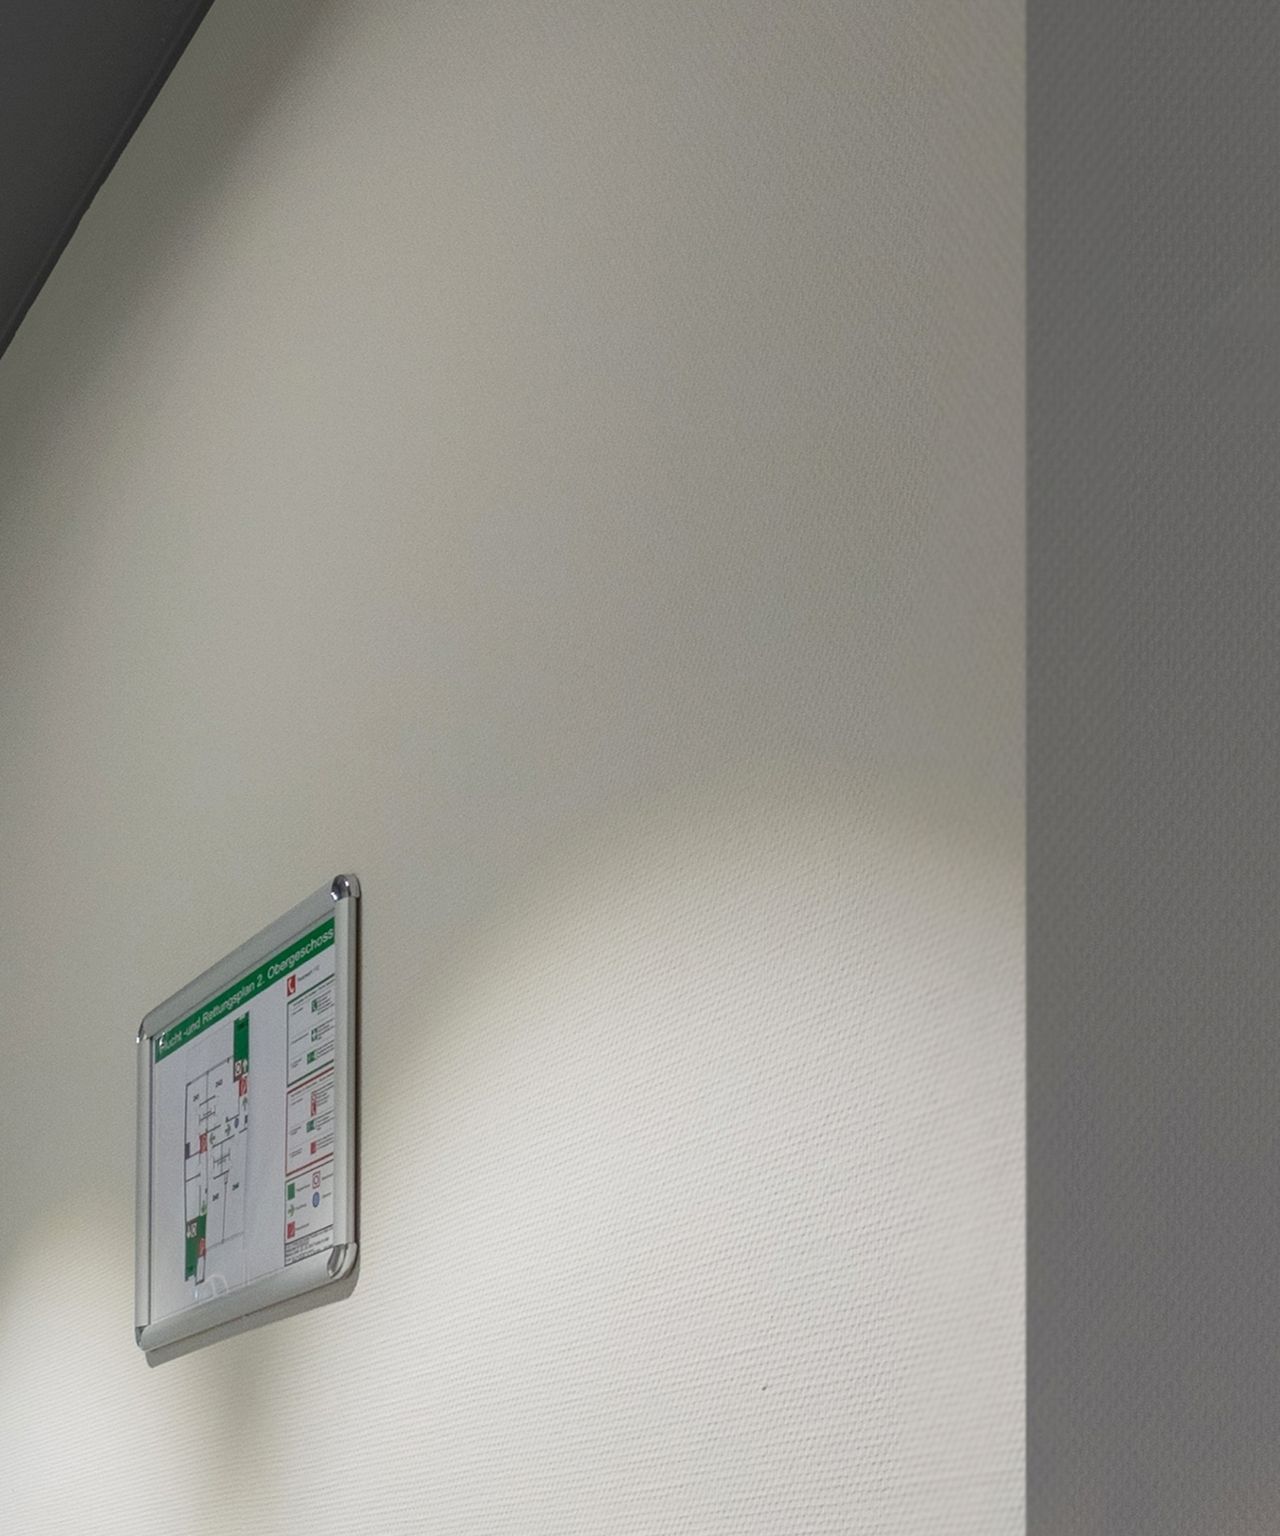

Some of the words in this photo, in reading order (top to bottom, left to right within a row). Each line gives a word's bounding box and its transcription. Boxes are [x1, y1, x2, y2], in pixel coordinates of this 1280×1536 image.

[202, 982, 255, 1025] Rettungsplan
[256, 974, 265, 988] 2.
[267, 928, 333, 979] Obergeschoss
